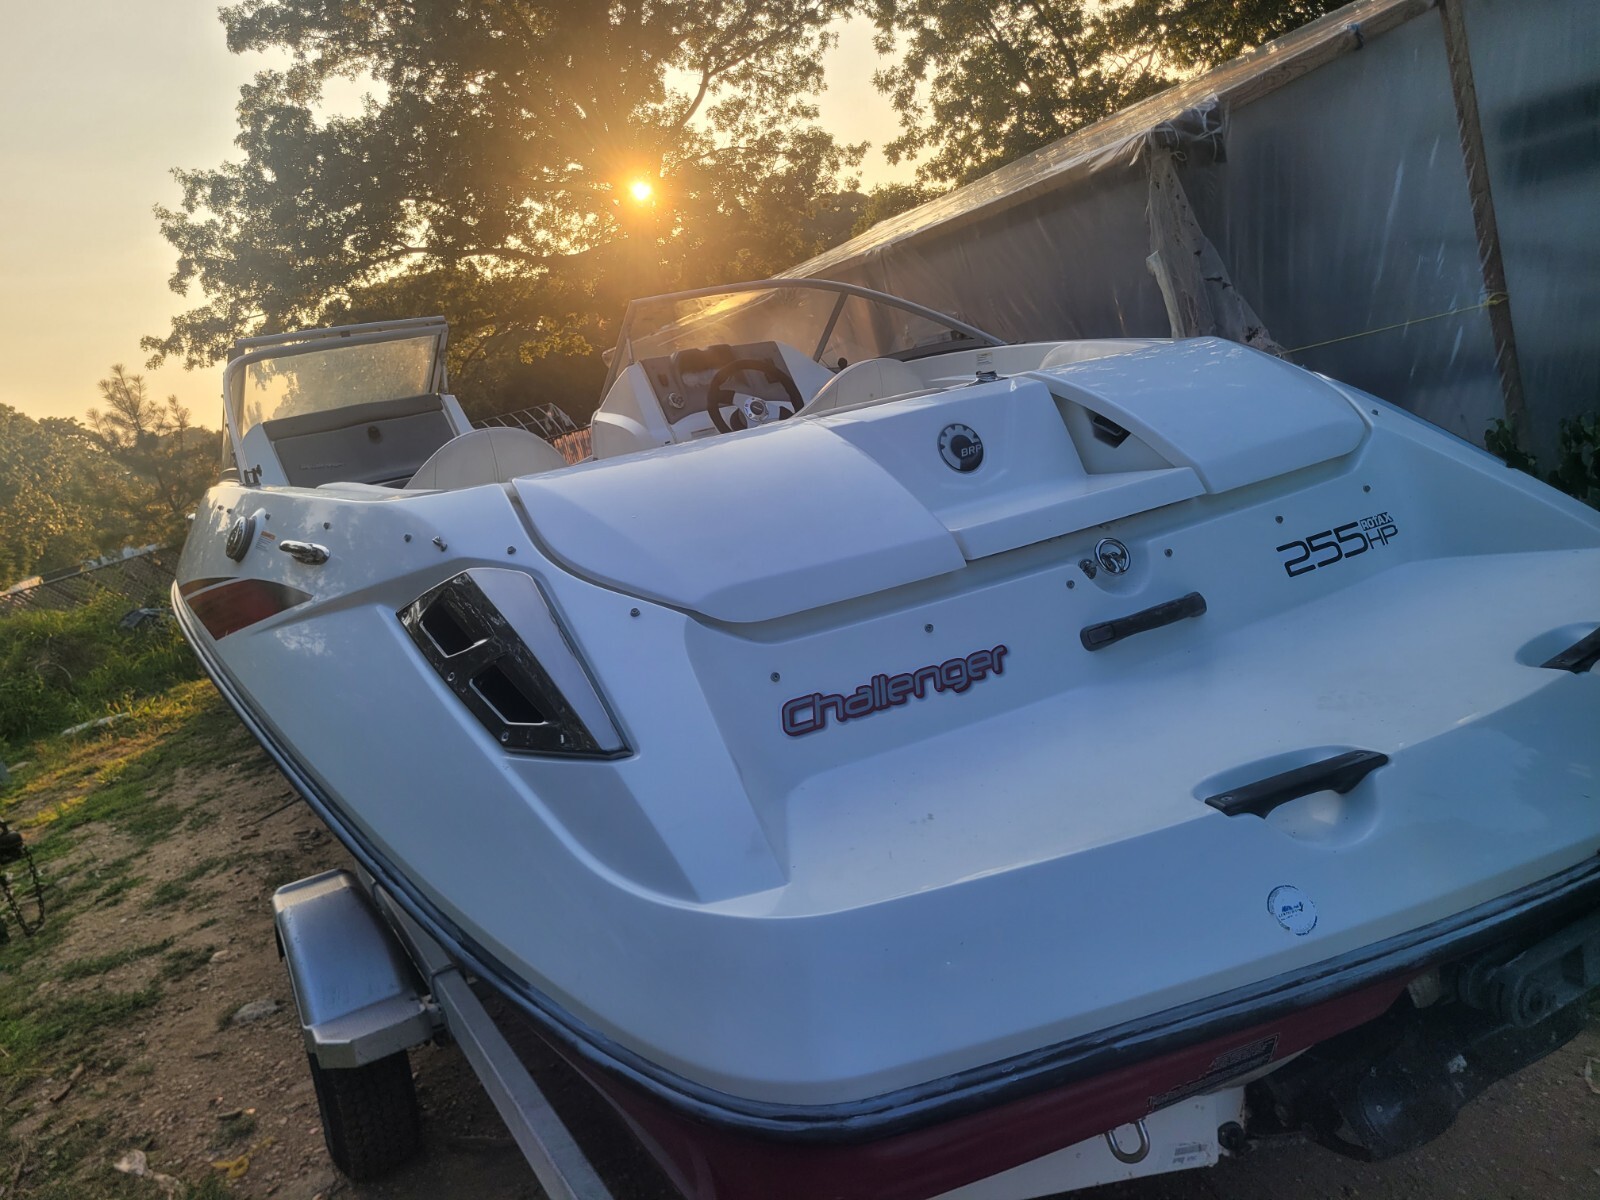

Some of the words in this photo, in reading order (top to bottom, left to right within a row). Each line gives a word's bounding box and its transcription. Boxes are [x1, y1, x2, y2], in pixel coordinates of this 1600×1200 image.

[961, 444, 982, 457] BRP
[1359, 512, 1394, 532] ROTAX
[1276, 521, 1369, 578] 255
[1365, 524, 1399, 550] HP
[782, 644, 1008, 737] Challenger
